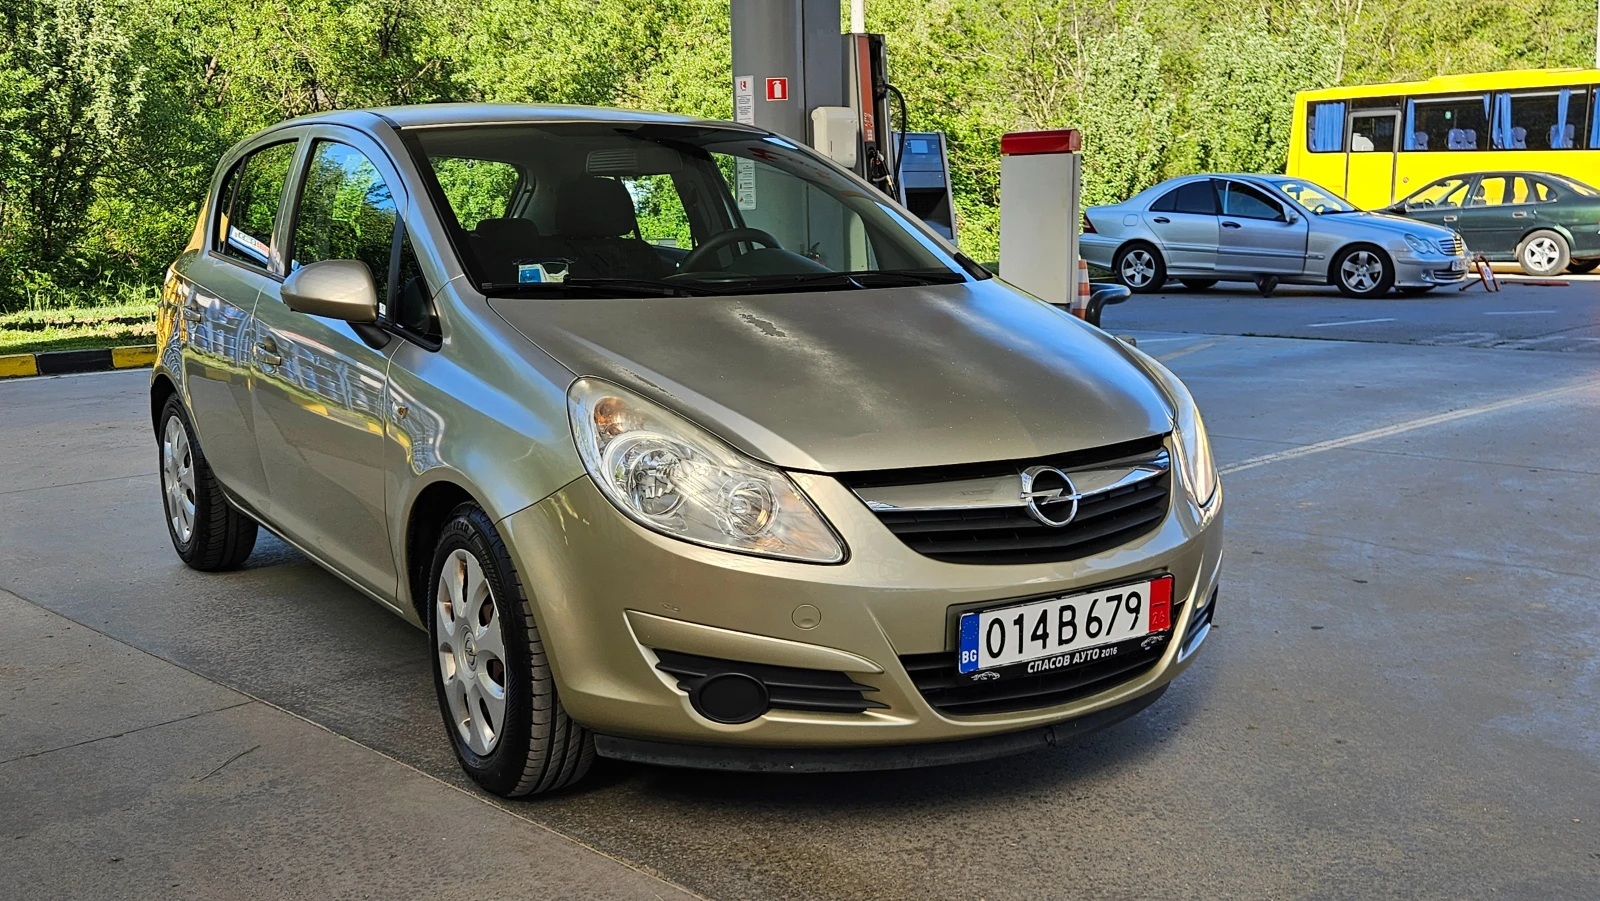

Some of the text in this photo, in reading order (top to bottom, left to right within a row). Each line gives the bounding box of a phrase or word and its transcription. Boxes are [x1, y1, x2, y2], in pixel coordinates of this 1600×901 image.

[986, 591, 1142, 659] 014B679
[962, 649, 978, 664] BG
[1027, 646, 1118, 673] СПАСОВ АУТО 2016
